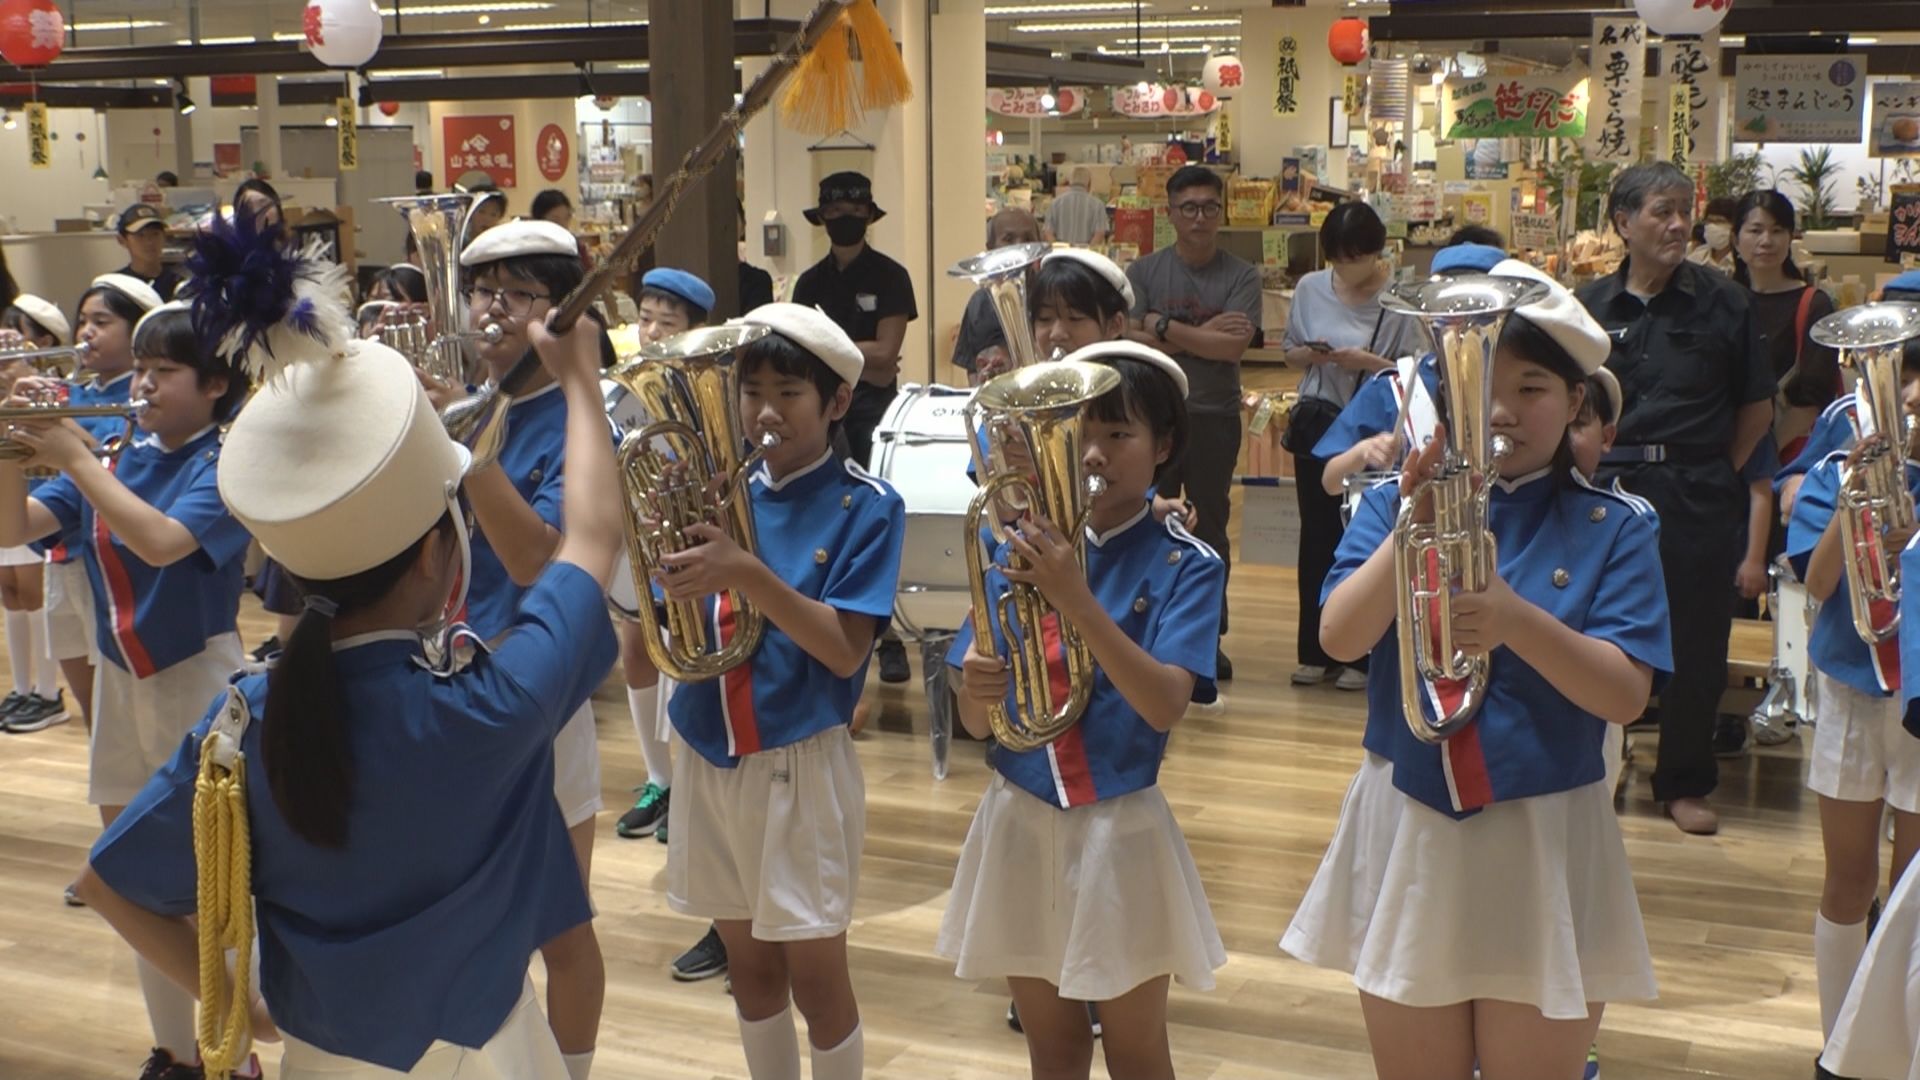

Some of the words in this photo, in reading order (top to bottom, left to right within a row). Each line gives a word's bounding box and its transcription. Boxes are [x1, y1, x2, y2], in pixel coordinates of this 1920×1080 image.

[1600, 24, 1640, 45] 名代
[1219, 64, 1242, 88] 祭
[1122, 101, 1160, 113] とみさわ
[1494, 80, 1580, 129] 笹だんご
[1596, 51, 1631, 158] 栗どら焼
